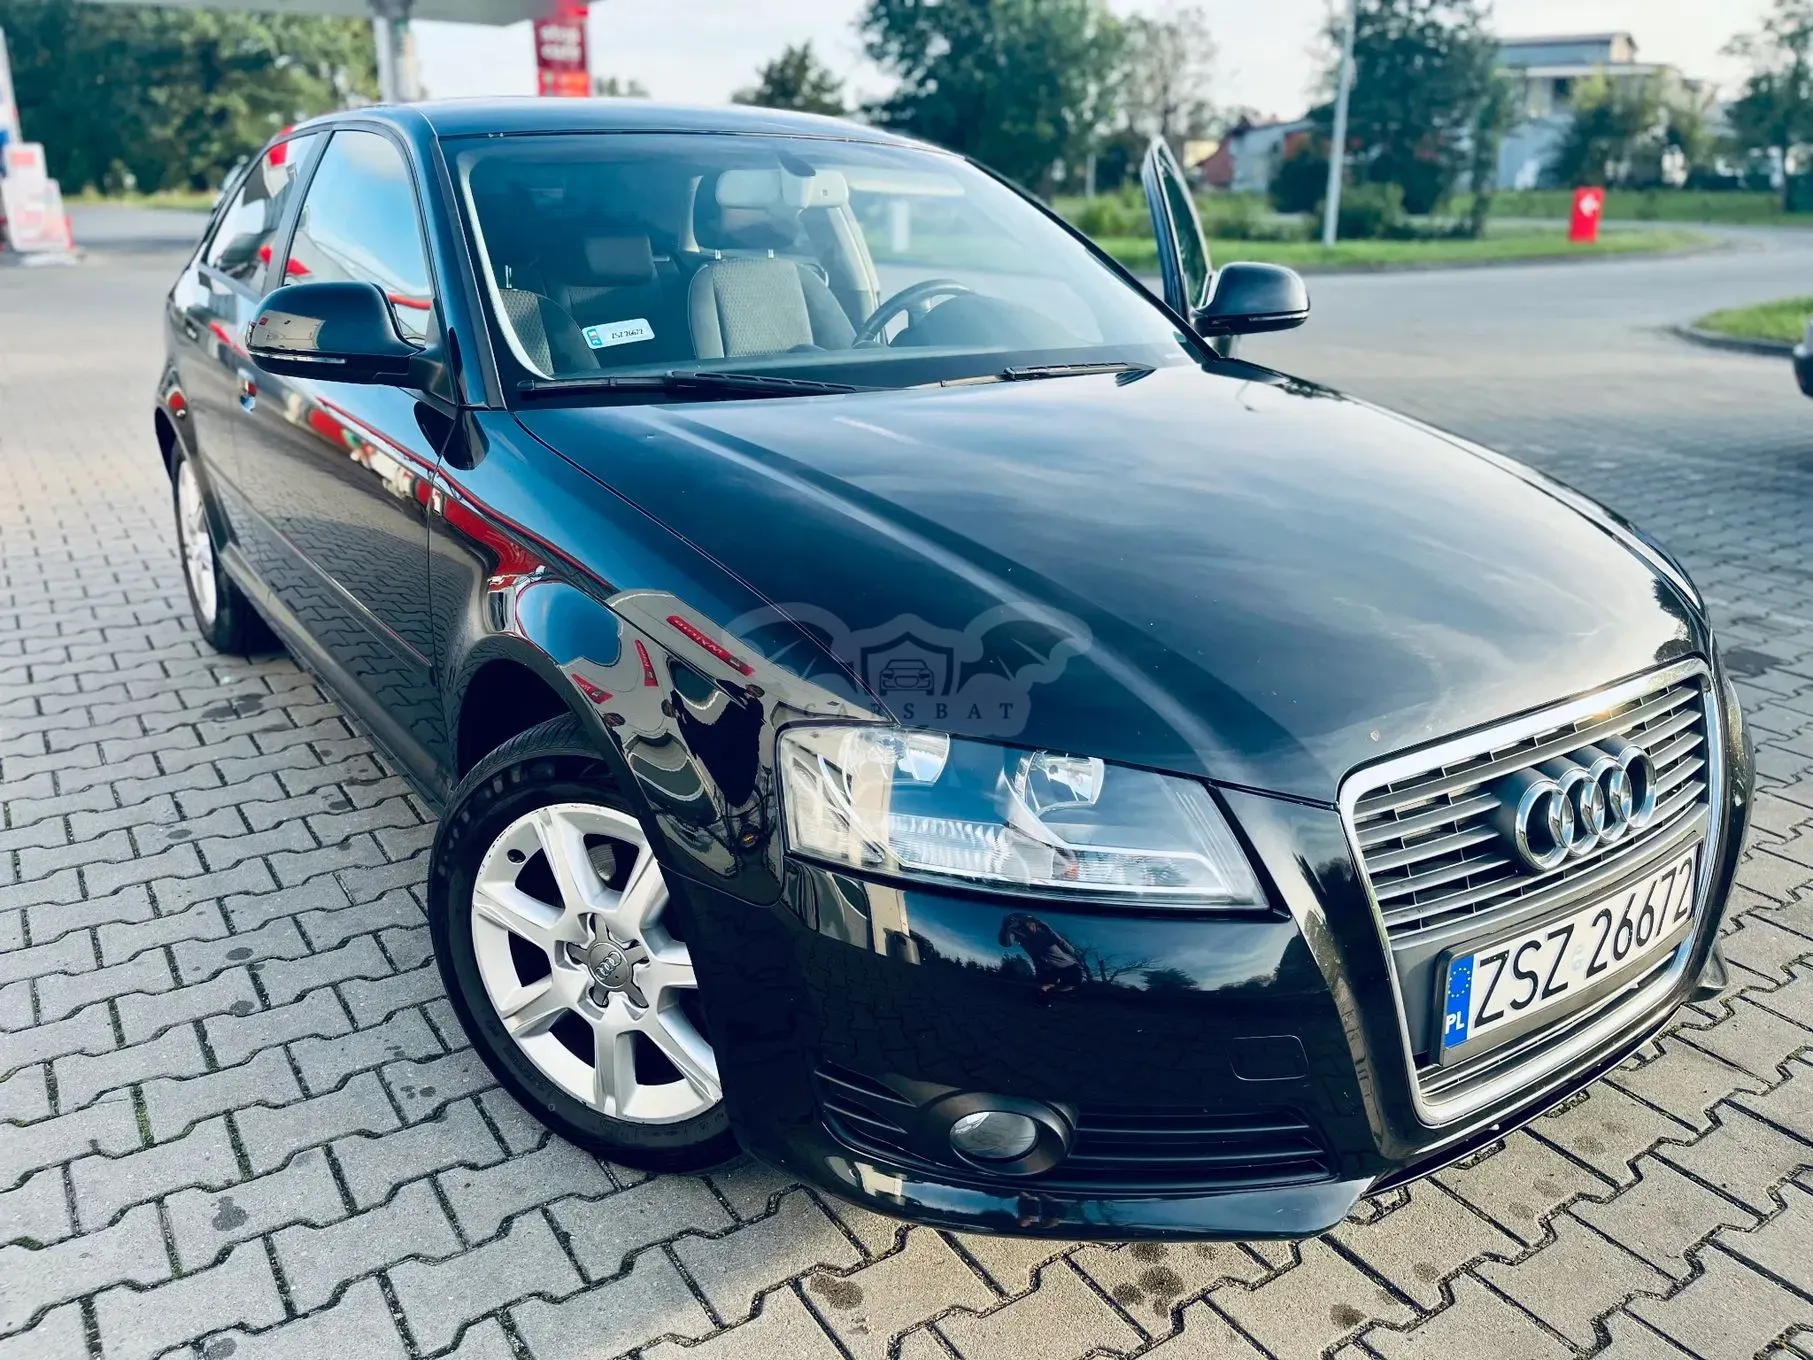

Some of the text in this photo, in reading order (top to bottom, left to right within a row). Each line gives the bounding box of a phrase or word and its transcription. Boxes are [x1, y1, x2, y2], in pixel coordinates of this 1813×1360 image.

[1474, 857, 1693, 1029] ZSZ 26672
[1445, 1011, 1465, 1035] PL
